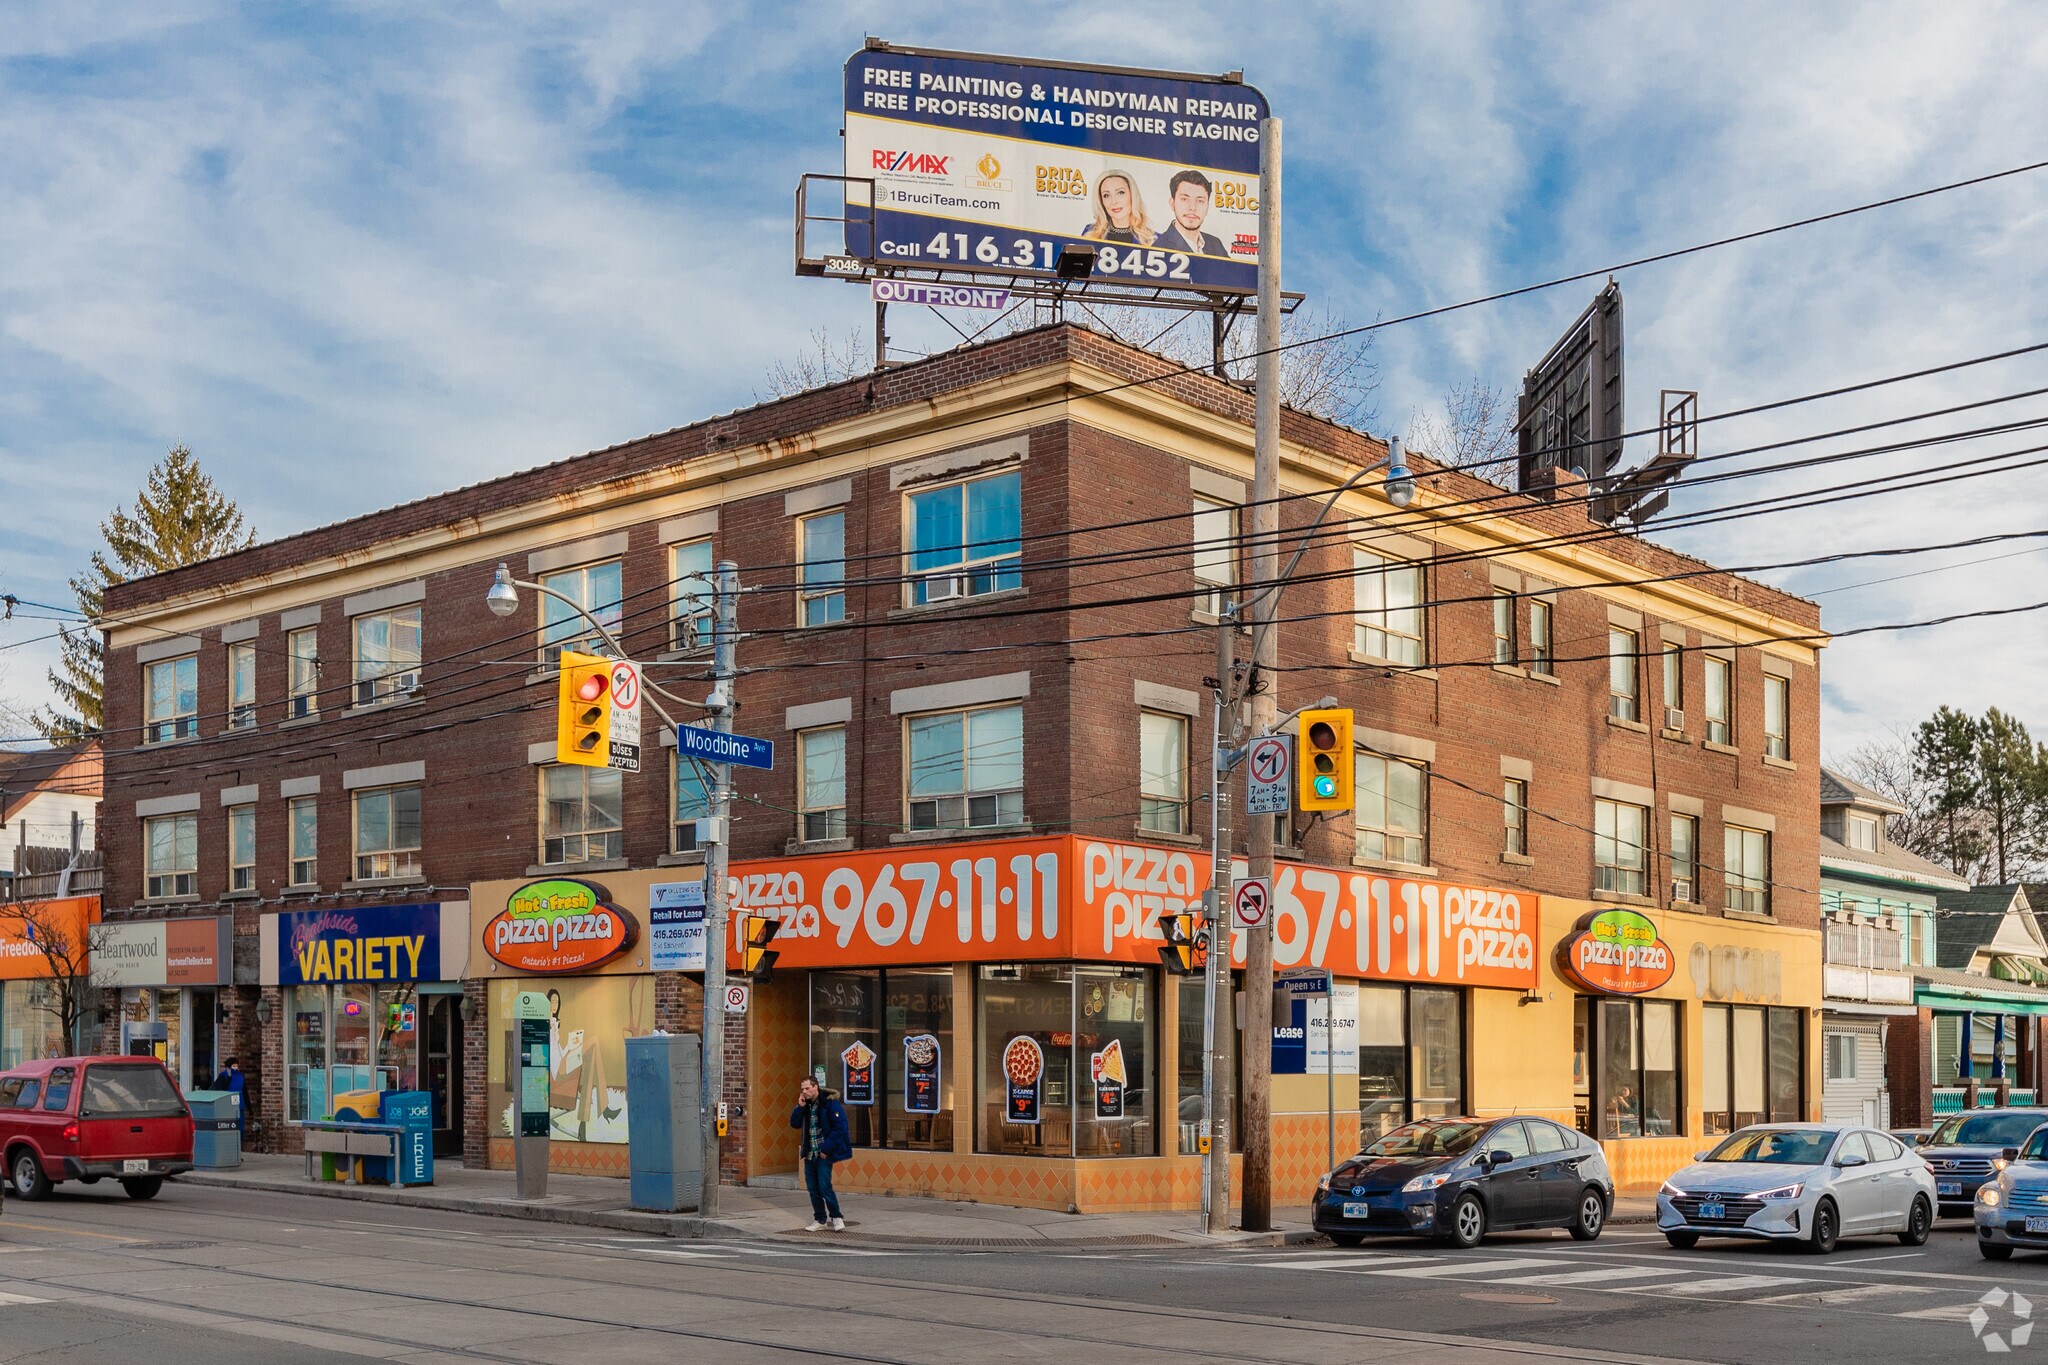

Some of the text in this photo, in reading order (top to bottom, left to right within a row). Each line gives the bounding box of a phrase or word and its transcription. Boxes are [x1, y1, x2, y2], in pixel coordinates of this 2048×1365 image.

[864, 67, 1258, 121] FREE PAINTING & HANDYMAN REPAIR
[864, 91, 1260, 143] FREE PROFESSIONAL DESIGNER STAGING
[1035, 165, 1084, 183] DRITA
[976, 180, 1001, 189] BRUCI
[1035, 179, 1087, 196] BRUCI
[1215, 181, 1247, 197] LOU
[889, 190, 1000, 210] 1BruciTeam.com
[1215, 195, 1260, 211] BRUC
[1235, 233, 1257, 244] TOP
[880, 240, 920, 257] Call
[828, 258, 860, 271] 3046
[876, 282, 1004, 308] OUTFRONT
[612, 744, 633, 757] BUSES
[685, 728, 766, 758] Woodbine Ave
[609, 755, 638, 769] XCEPTED
[1250, 785, 1265, 795] 7AM
[1271, 783, 1287, 794] 9AM
[1249, 795, 1265, 805] 4PM
[1271, 793, 1287, 803] 6PM
[1253, 804, 1267, 812] MON
[514, 891, 590, 915] Hot & Fresh
[653, 909, 703, 920] Retail for Lease
[1444, 887, 1520, 939] pizza
[291, 911, 359, 960] Beachside
[494, 911, 613, 954] pizza pizza
[653, 928, 703, 939] 416.269.6747
[1596, 921, 1617, 938] Hot
[1622, 923, 1651, 942] Fresh
[98, 937, 158, 959] Heartwood
[1457, 927, 1533, 979] pizza
[298, 935, 425, 981] VARIETY
[521, 952, 586, 966] Ontario's #1 Pizza!
[1580, 939, 1623, 972] pizza
[1625, 944, 1667, 976] pizza
[1284, 980, 1308, 991] Queen
[1317, 979, 1322, 990] E
[1602, 976, 1649, 989] Ontario's #1 Pizza!
[1310, 1018, 1355, 1028] 416.29.6747
[1273, 1027, 1304, 1039] Lease
[389, 1107, 402, 1117] JOB
[409, 1105, 429, 1116] JOB
[414, 1133, 424, 1178] FREE
